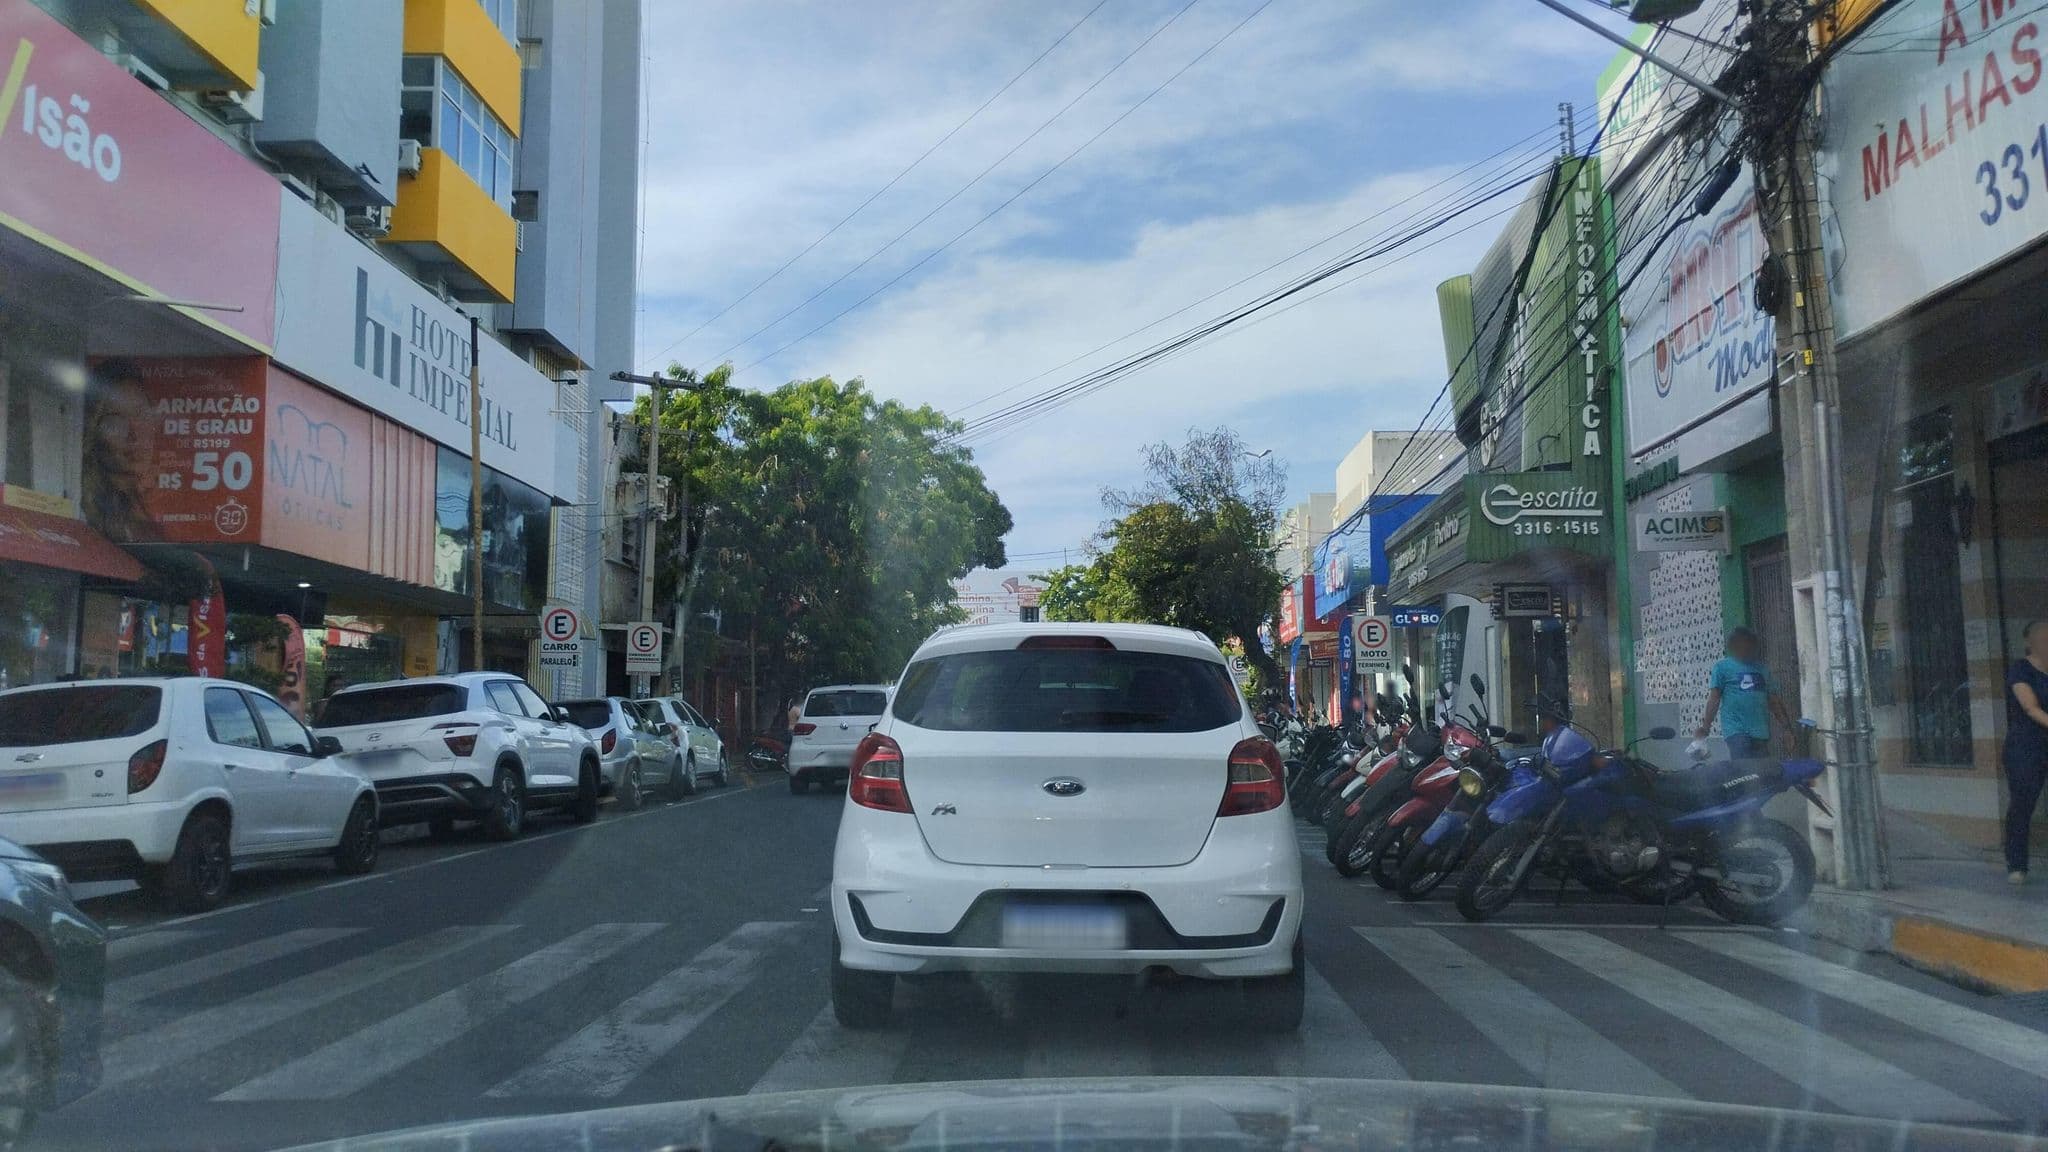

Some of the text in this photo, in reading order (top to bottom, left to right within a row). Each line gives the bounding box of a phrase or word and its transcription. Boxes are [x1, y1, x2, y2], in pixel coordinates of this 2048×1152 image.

[1862, 22, 2042, 202] MALHAS
[410, 303, 485, 388] HOTE
[158, 393, 261, 418] ARMAÇÃO
[164, 419, 253, 435] DE GRAU
[158, 471, 182, 491] R$
[191, 450, 253, 491] 50
[270, 439, 353, 509] NATAL
[554, 615, 567, 635] E
[1367, 625, 1378, 643] E
[542, 643, 578, 651] CARRO
[639, 631, 650, 647] E
[540, 656, 573, 666] PARALELO
[1360, 650, 1388, 658] MOTO
[1723, 773, 1759, 789] HONDA
